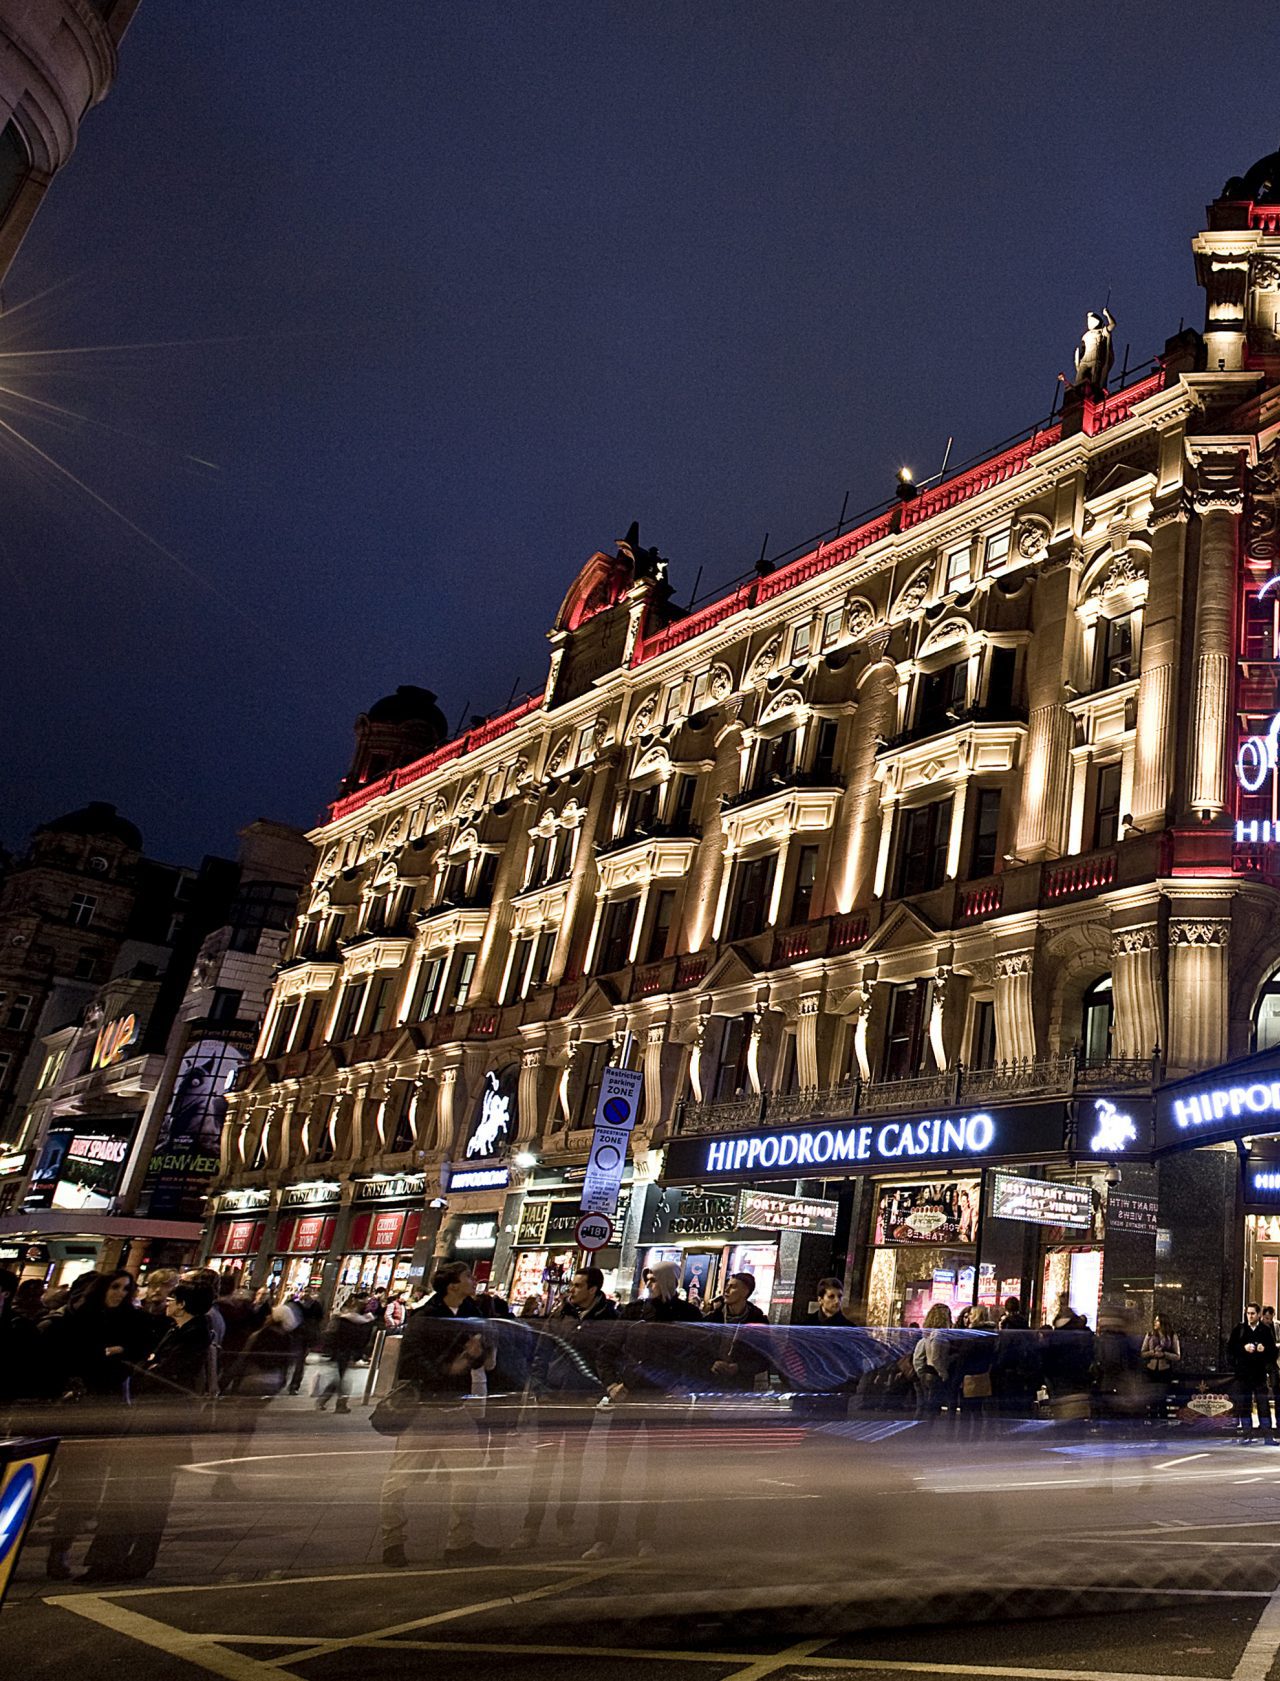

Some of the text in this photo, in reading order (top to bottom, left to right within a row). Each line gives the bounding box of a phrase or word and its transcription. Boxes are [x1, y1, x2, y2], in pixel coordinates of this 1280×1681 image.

[605, 1069, 641, 1080] Restricted
[607, 1086, 634, 1097] ZONE
[608, 1079, 636, 1088] parking
[599, 1135, 623, 1145] ZONE
[705, 1114, 994, 1172] HIPPODROME CASINO
[88, 1140, 127, 1162] SPARKS
[999, 1182, 1088, 1203] RESTAURANT WITH
[522, 1205, 548, 1222] HALF
[746, 1200, 786, 1213] FORTY
[788, 1204, 833, 1218] GAMING
[1049, 1201, 1078, 1214] VIEWS
[764, 1212, 811, 1228] TABLES
[520, 1222, 545, 1238] PRICE
